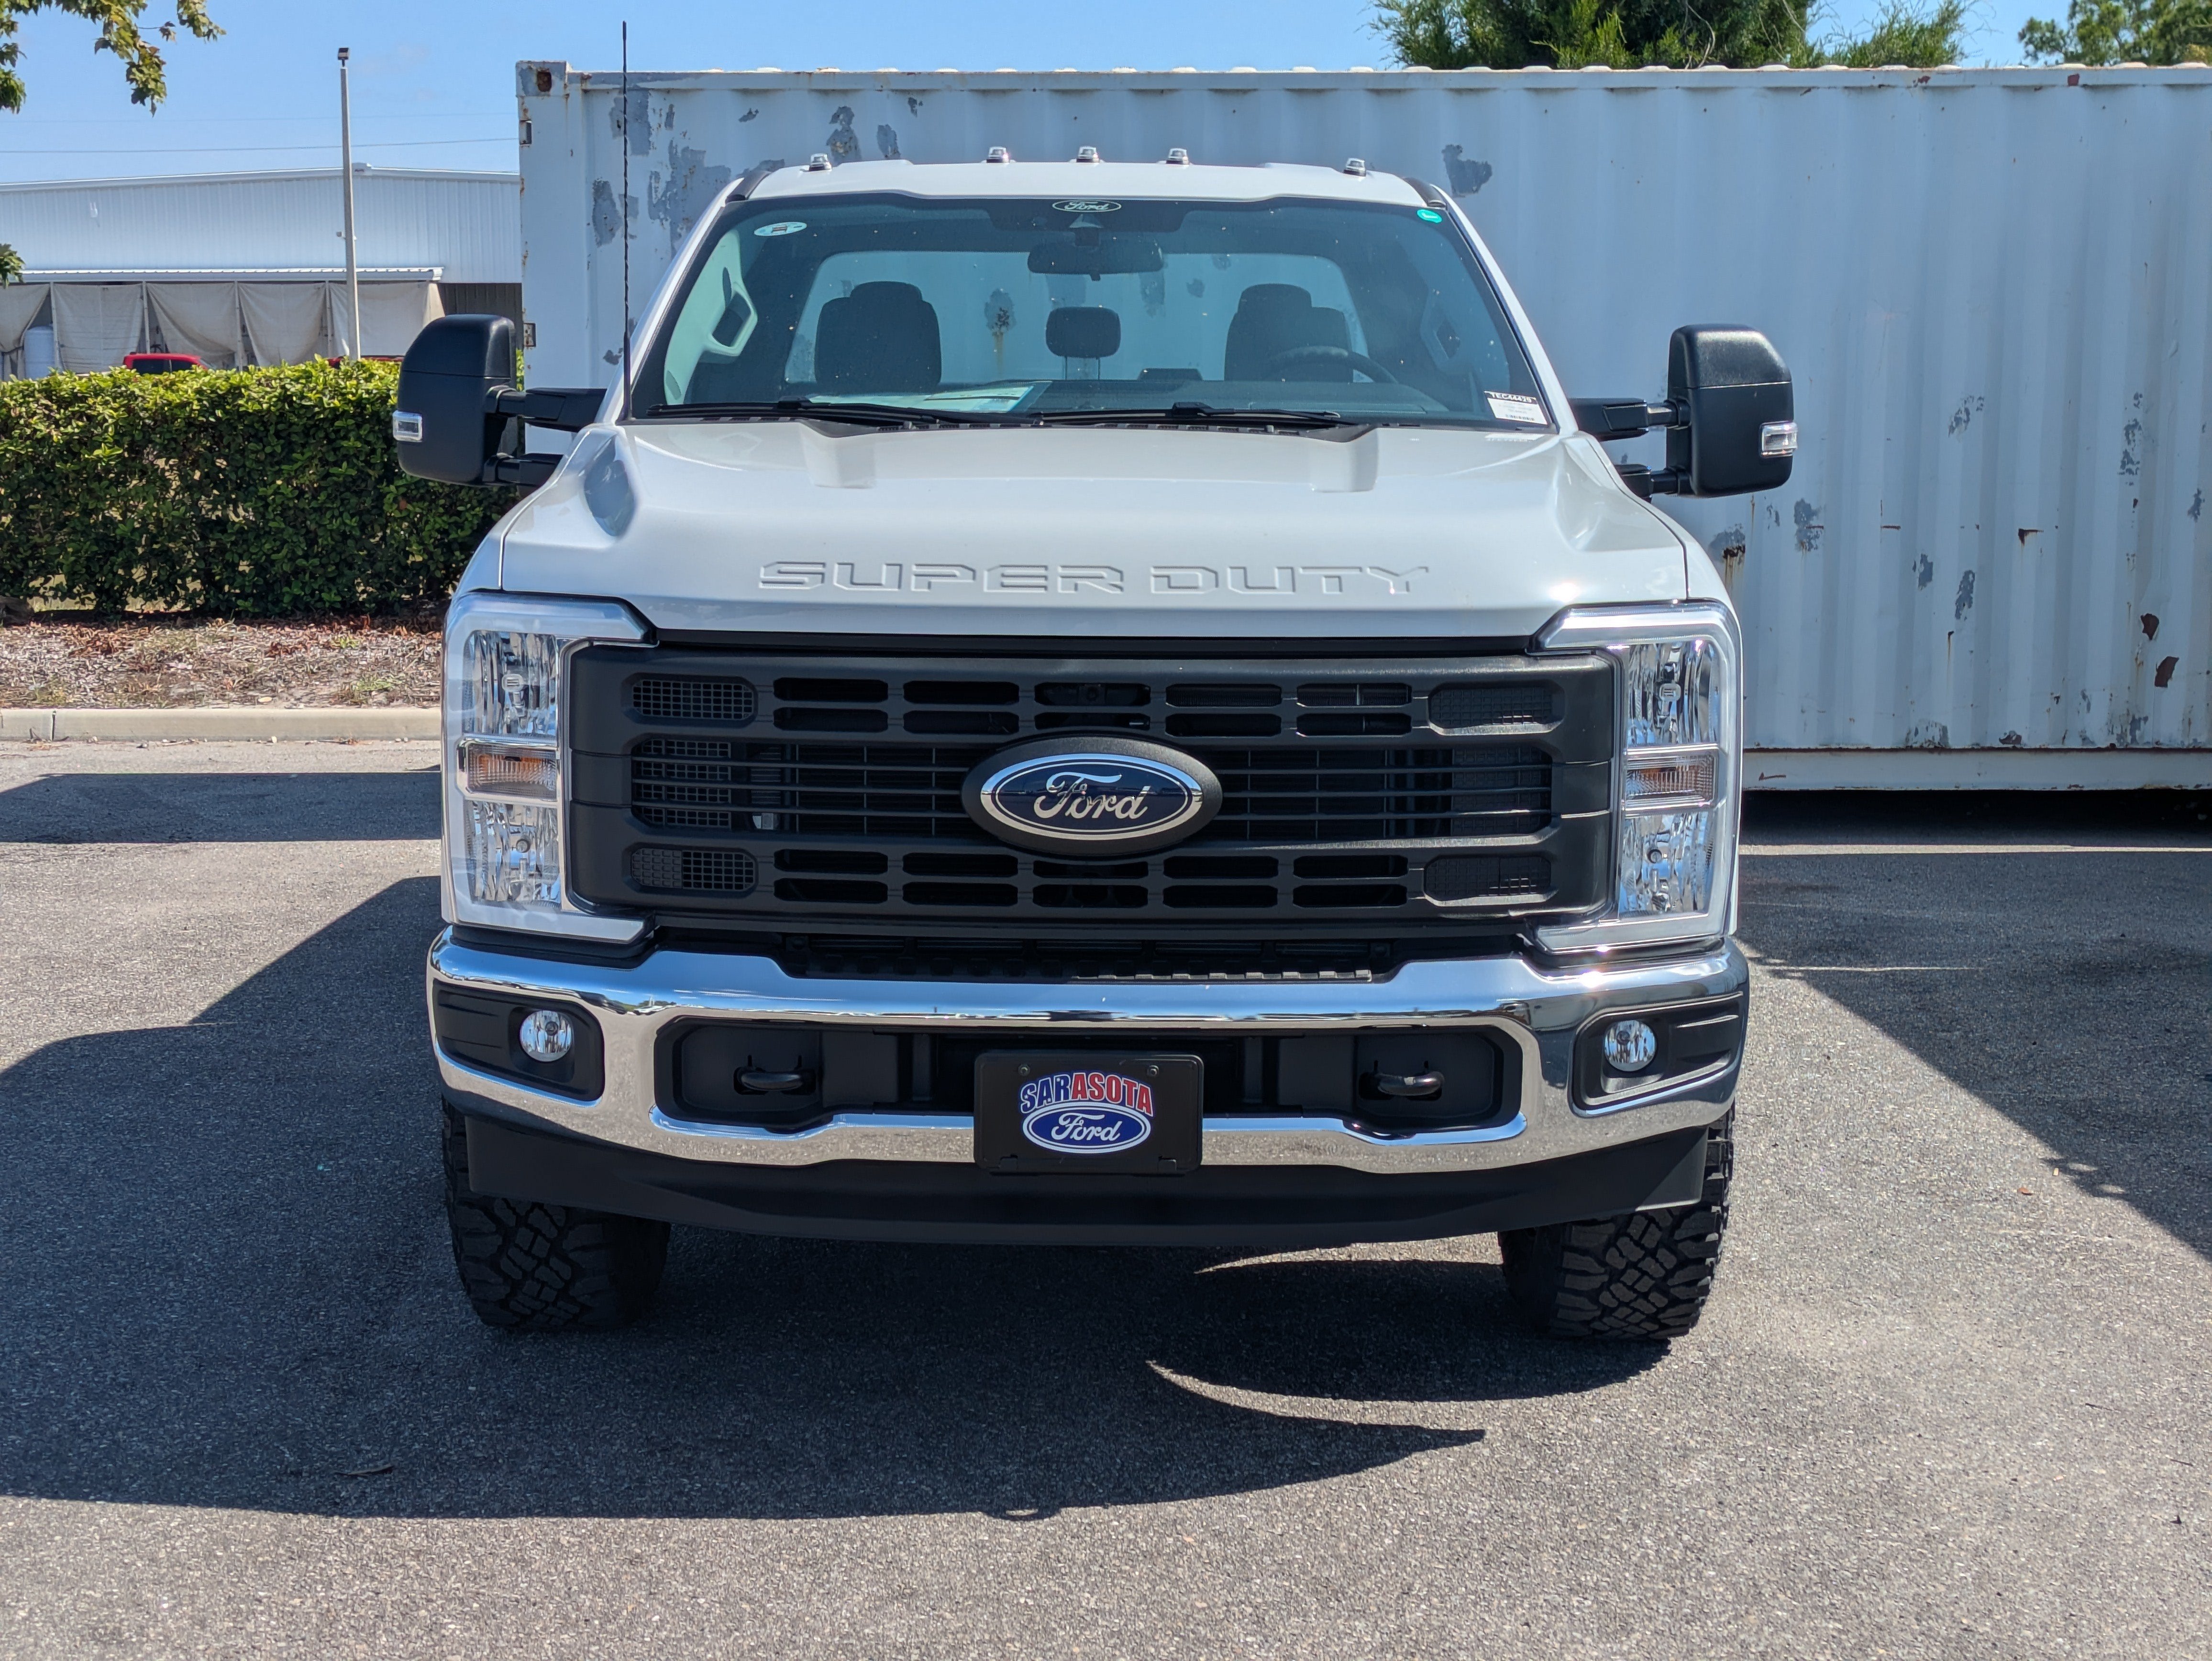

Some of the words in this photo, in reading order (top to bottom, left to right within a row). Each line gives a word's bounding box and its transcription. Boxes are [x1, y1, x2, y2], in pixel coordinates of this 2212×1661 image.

[1064, 201, 1109, 210] Ford
[759, 561, 1124, 594] SUPER
[1150, 565, 1429, 594] DUTY
[1034, 771, 1150, 819] Ford
[1020, 1072, 1154, 1117] SARASOTA
[1051, 1112, 1123, 1141] Ford
